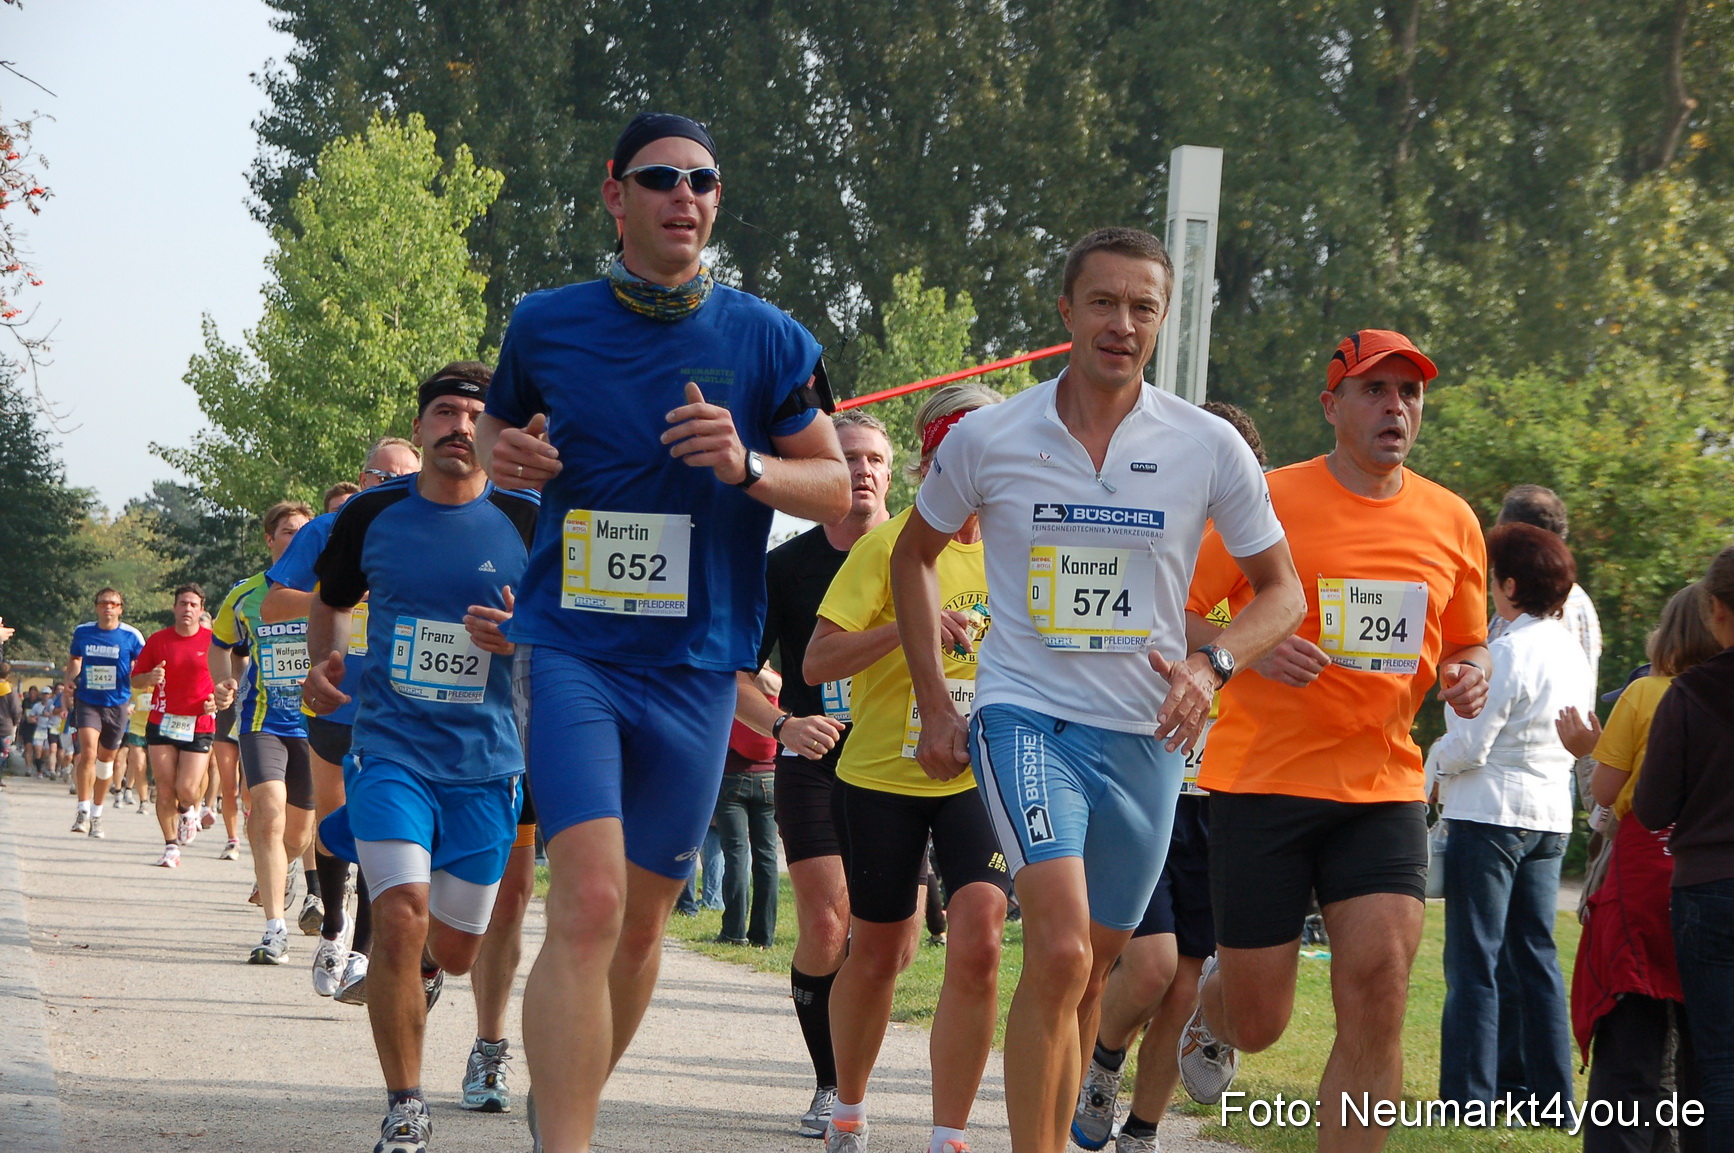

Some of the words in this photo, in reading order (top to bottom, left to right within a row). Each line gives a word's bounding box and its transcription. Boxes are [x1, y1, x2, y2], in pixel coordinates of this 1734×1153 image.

[1073, 508, 1160, 526] BÜSCHEL
[596, 519, 649, 541] Martin
[1032, 524, 1106, 534] FEINSCHNEIDTECHNIK
[1112, 528, 1164, 539] WERKZEUGBAU
[568, 546, 576, 561] C
[607, 552, 668, 582] 652
[1061, 555, 1118, 576] Konrad
[1032, 585, 1039, 600] D
[1350, 586, 1383, 605] Hans
[638, 600, 685, 609] PFLEIDERER
[1073, 588, 1132, 617] 574
[1325, 613, 1332, 625] B
[421, 626, 455, 645] Franz
[1359, 616, 1408, 642] 294
[275, 647, 307, 657] Wolfgang
[397, 645, 404, 657] B
[278, 659, 310, 672] 3166
[419, 650, 480, 676] 3652
[1382, 659, 1418, 668] PFLEIDERER
[448, 690, 483, 699] PFLEIDERER
